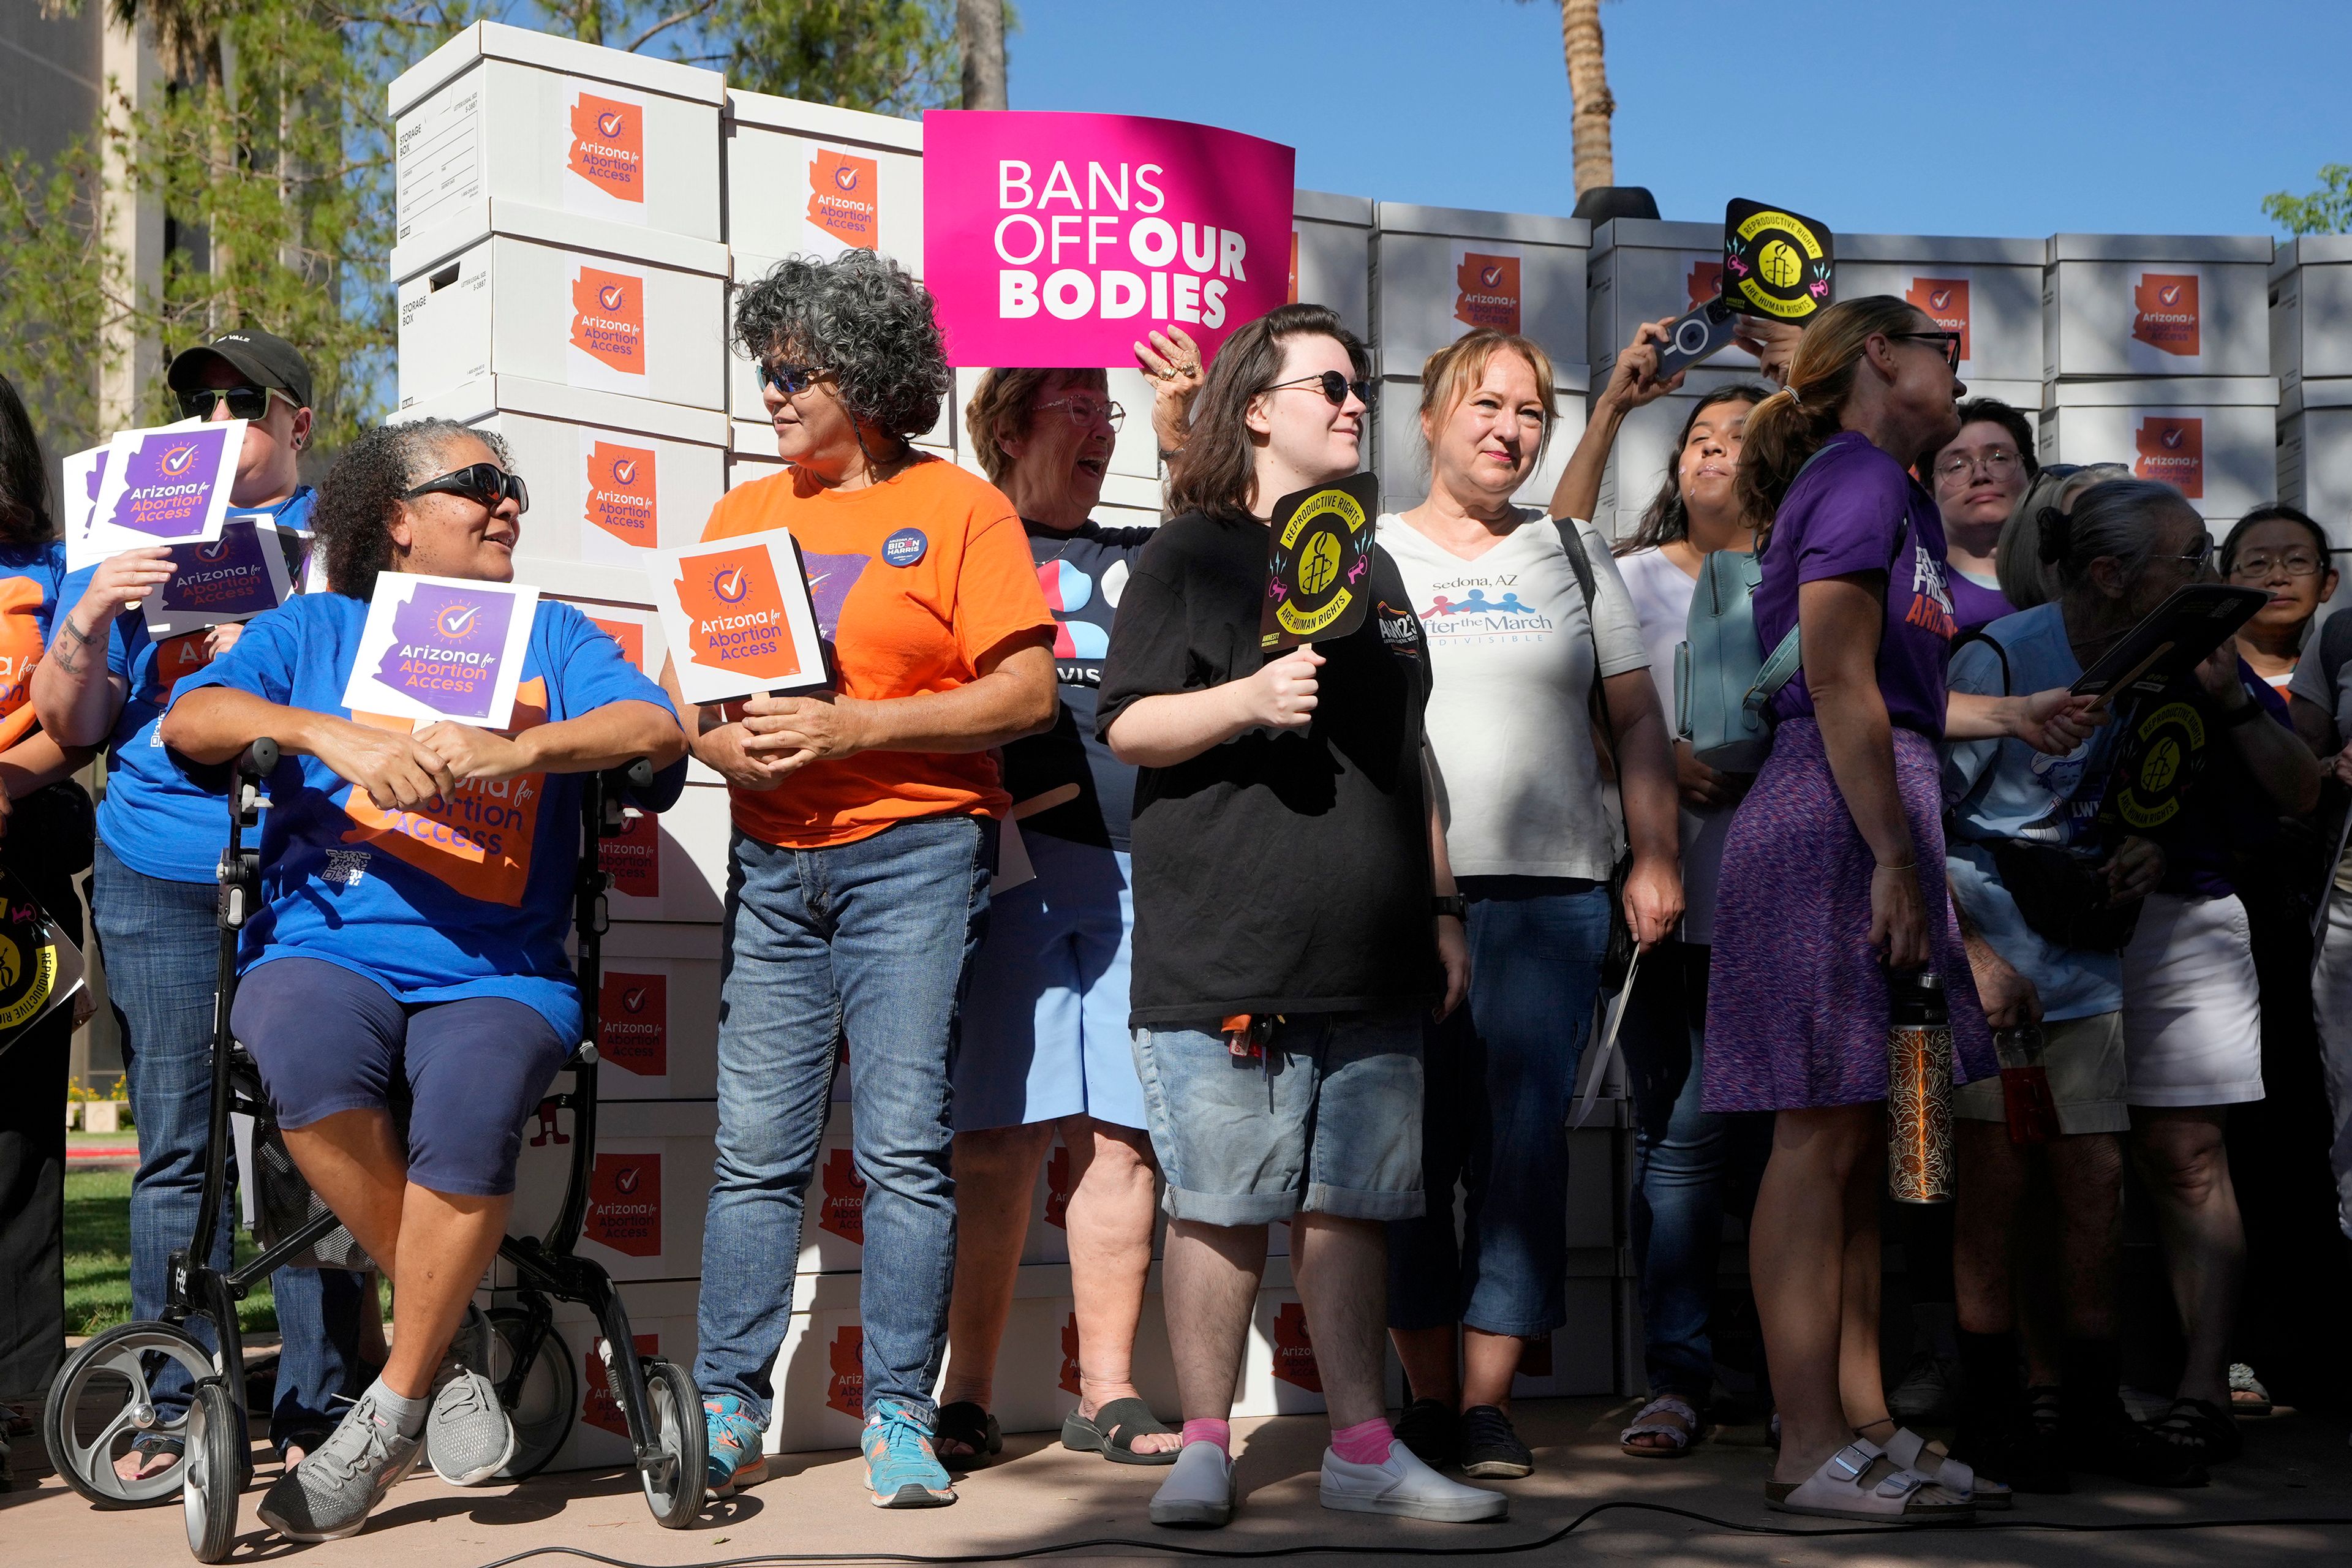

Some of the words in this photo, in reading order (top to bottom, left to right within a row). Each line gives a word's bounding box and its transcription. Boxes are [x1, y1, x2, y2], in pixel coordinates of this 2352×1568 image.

[466, 100, 478, 113] S-3887
[399, 124, 421, 146] STORAGE
[399, 142, 410, 157] BOX
[579, 141, 630, 160] Arizona
[631, 152, 639, 164] for
[583, 154, 637, 173] Abortion
[589, 166, 631, 183] Access
[999, 160, 1165, 213] BANS
[818, 195, 865, 211] Arizona
[821, 206, 871, 223] Abortion
[826, 217, 865, 232] Access
[1744, 217, 1795, 235] REPRODUCTIVE
[1796, 228, 1818, 255] RIGHTS
[993, 213, 1118, 265] OFF
[1129, 216, 1246, 282] OUR
[473, 279, 486, 291] S-3887
[403, 295, 426, 315] STORAGE
[999, 268, 1229, 330] BODIES
[1465, 293, 1508, 305] Arizona
[1744, 284, 1759, 299] ARE
[1759, 296, 1785, 314] HUMAN
[1787, 300, 1811, 314] RIGHTS
[1468, 304, 1514, 315] Abortion
[2143, 312, 2187, 323] Arizona
[403, 313, 414, 326] BOX
[582, 315, 630, 332] Arizona
[1472, 313, 1509, 324] Access
[2146, 323, 2193, 332] Abortion
[585, 328, 638, 345] Abortion
[591, 340, 632, 355] Access
[2144, 455, 2190, 466] Arizona
[2147, 466, 2195, 474] Abortion
[130, 483, 197, 500] Arizona
[197, 481, 211, 495] for
[597, 490, 643, 506] Arizona
[130, 495, 202, 512] Abortion
[599, 502, 650, 518] Abortion
[135, 507, 191, 523] Access
[605, 514, 644, 528] Access
[1286, 496, 1337, 541] REPRODUCTIVE
[1338, 499, 1360, 526] RIGHTS
[888, 540, 920, 550] BIDEN
[888, 546, 919, 555] HARRIS
[176, 566, 247, 588] Arizona
[251, 564, 262, 577] for
[1495, 575, 1520, 587] AZ
[184, 575, 261, 598] Abortion
[195, 586, 255, 605] Access
[1280, 608, 1292, 625] ARE
[1292, 619, 1316, 630] HUMAN
[1319, 595, 1345, 625] RIGHTS
[701, 611, 768, 634] Arizona
[771, 609, 781, 625] for
[1422, 619, 1459, 635] fter
[1461, 618, 1483, 627] the
[1485, 614, 1553, 631] March
[709, 625, 782, 649] Abortion
[1262, 632, 1280, 643] AMNESTY
[1427, 635, 1544, 646] NDIVISIBLE
[399, 644, 480, 664] Arizona
[480, 652, 496, 668] for
[720, 641, 778, 662] Access
[399, 660, 488, 681] Abortion
[404, 674, 474, 693] Access
[2143, 706, 2192, 735] REPRODUCTIVE
[2188, 714, 2201, 745] RIGHTS
[513, 779, 535, 807] for
[2120, 794, 2129, 811] ARE
[2127, 805, 2147, 824] HUMAN
[2149, 804, 2174, 824] RIGHTS
[388, 812, 503, 856] Access
[599, 856, 652, 868] Abortion
[13, 952, 51, 1019] REPRODUCTIVE
[604, 1021, 653, 1033] Arizona
[608, 1034, 660, 1046] Abortion
[613, 1046, 654, 1057] Access
[597, 1203, 647, 1215] Arizona
[831, 1196, 862, 1208] Arizo
[600, 1215, 654, 1227] Abortion
[605, 1227, 648, 1238] Access
[1282, 1346, 1313, 1357] Arizo
[839, 1373, 862, 1385] Ariz
